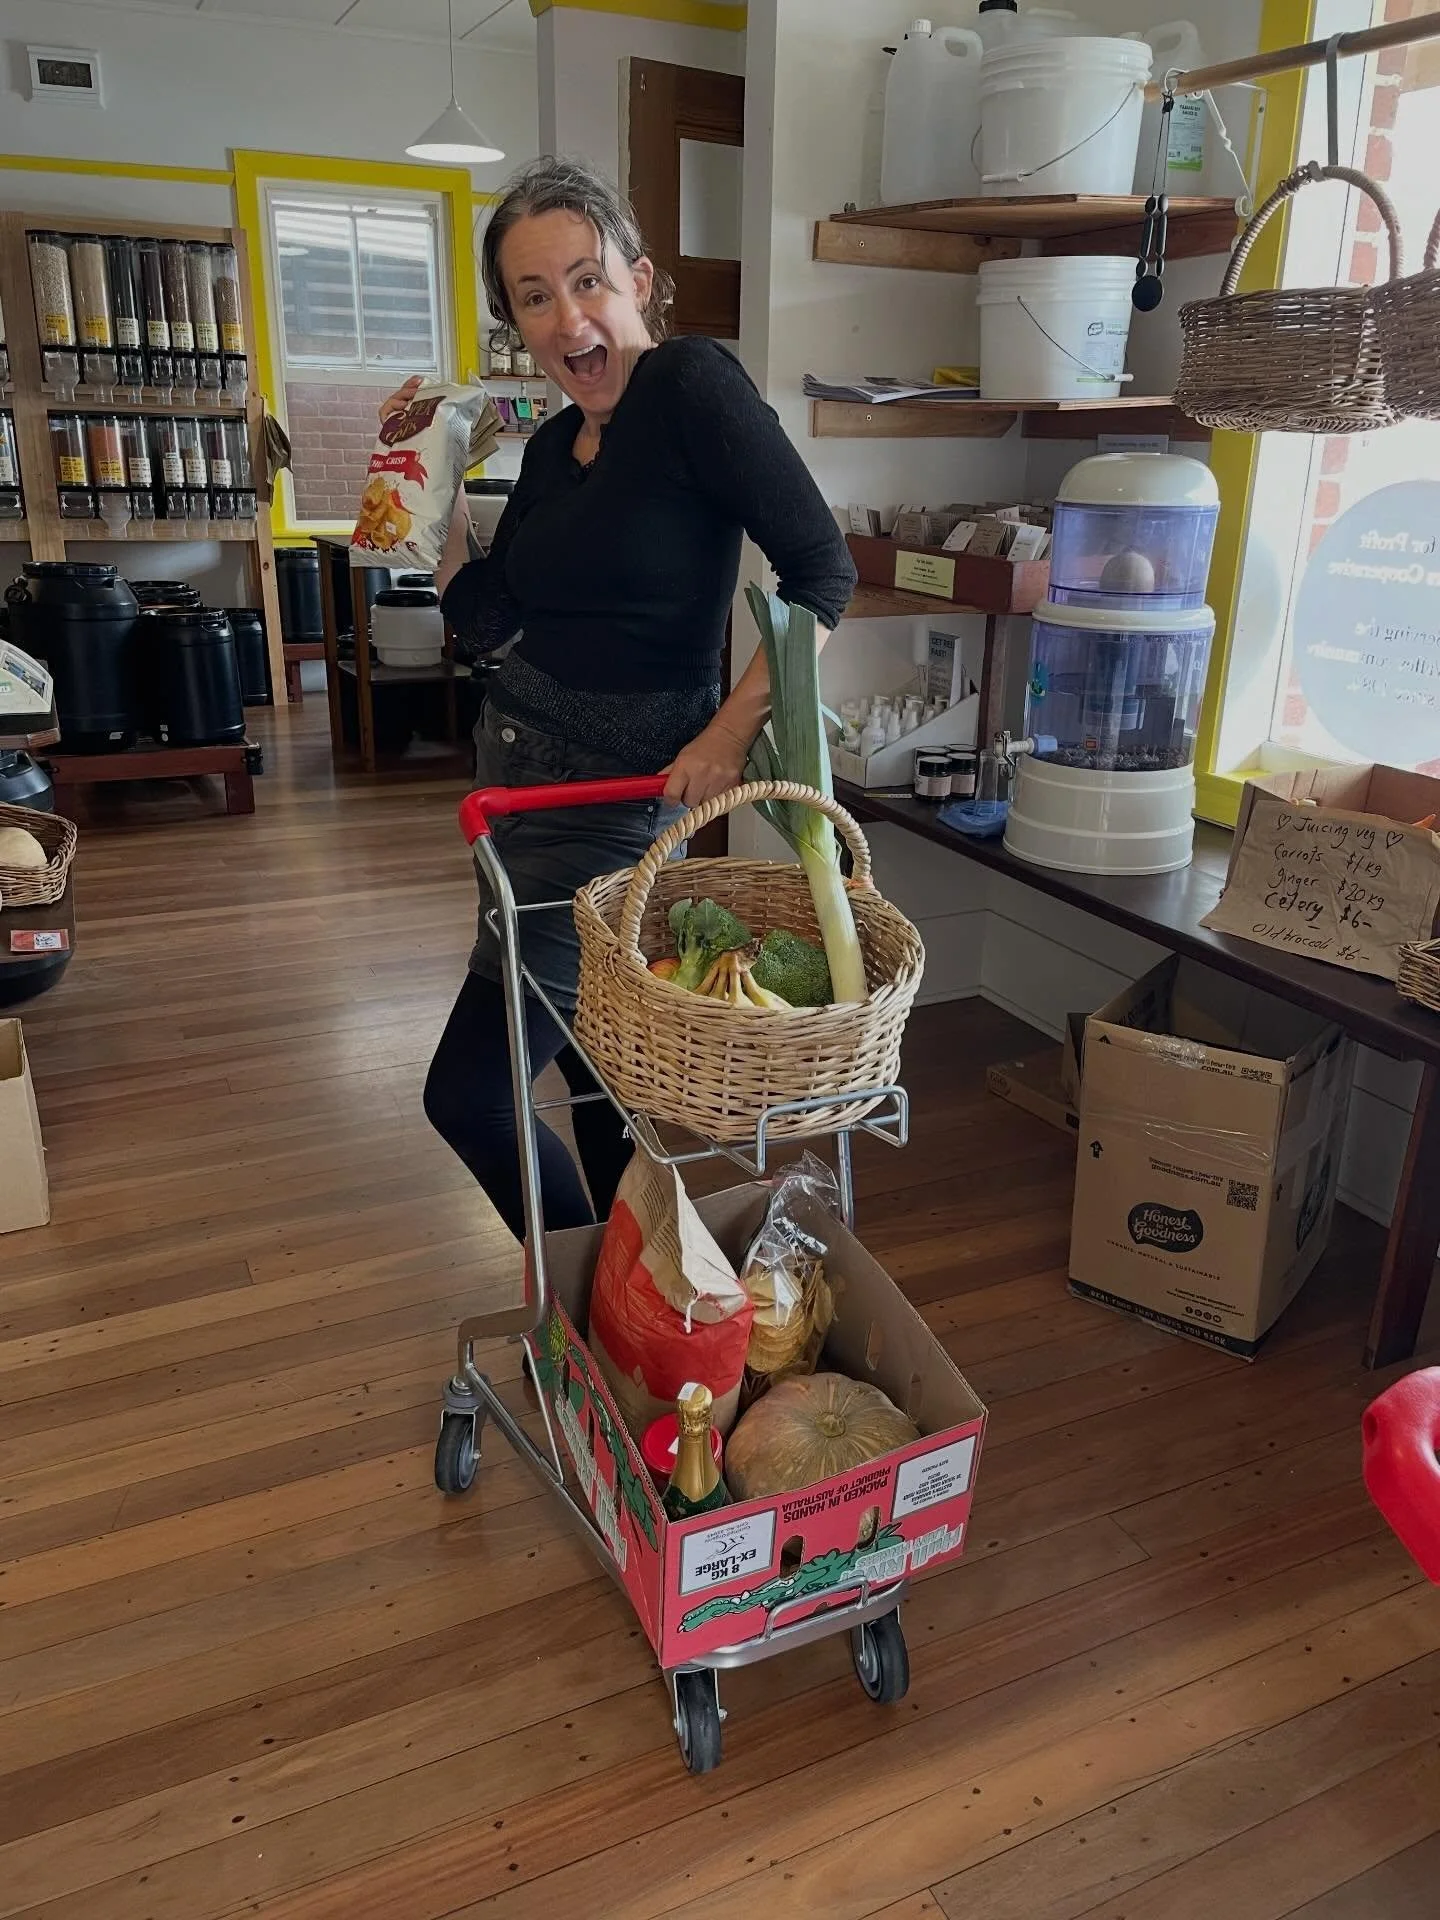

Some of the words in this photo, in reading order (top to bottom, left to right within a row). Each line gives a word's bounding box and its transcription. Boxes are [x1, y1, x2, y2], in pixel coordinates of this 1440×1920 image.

[386, 455, 407, 466] CRISP
[1293, 817, 1349, 849] Juicing
[1356, 827, 1376, 850] veg
[1264, 892, 1324, 922] Celery
[1151, 1163, 1221, 1187] goodness.com.au
[1132, 1217, 1196, 1244] Goodness
[1143, 1208, 1192, 1231] Honest
[836, 1483, 849, 1495] OF
[850, 1465, 892, 1489] PRODUCT
[781, 1488, 835, 1513] AUSTRALIA
[828, 1494, 841, 1509] IN
[843, 1476, 889, 1503] PACKED
[783, 1501, 826, 1524] HANDS
[695, 1548, 757, 1577] EX-LARGE
[711, 1567, 729, 1581] KG
[731, 1563, 740, 1574] 8
